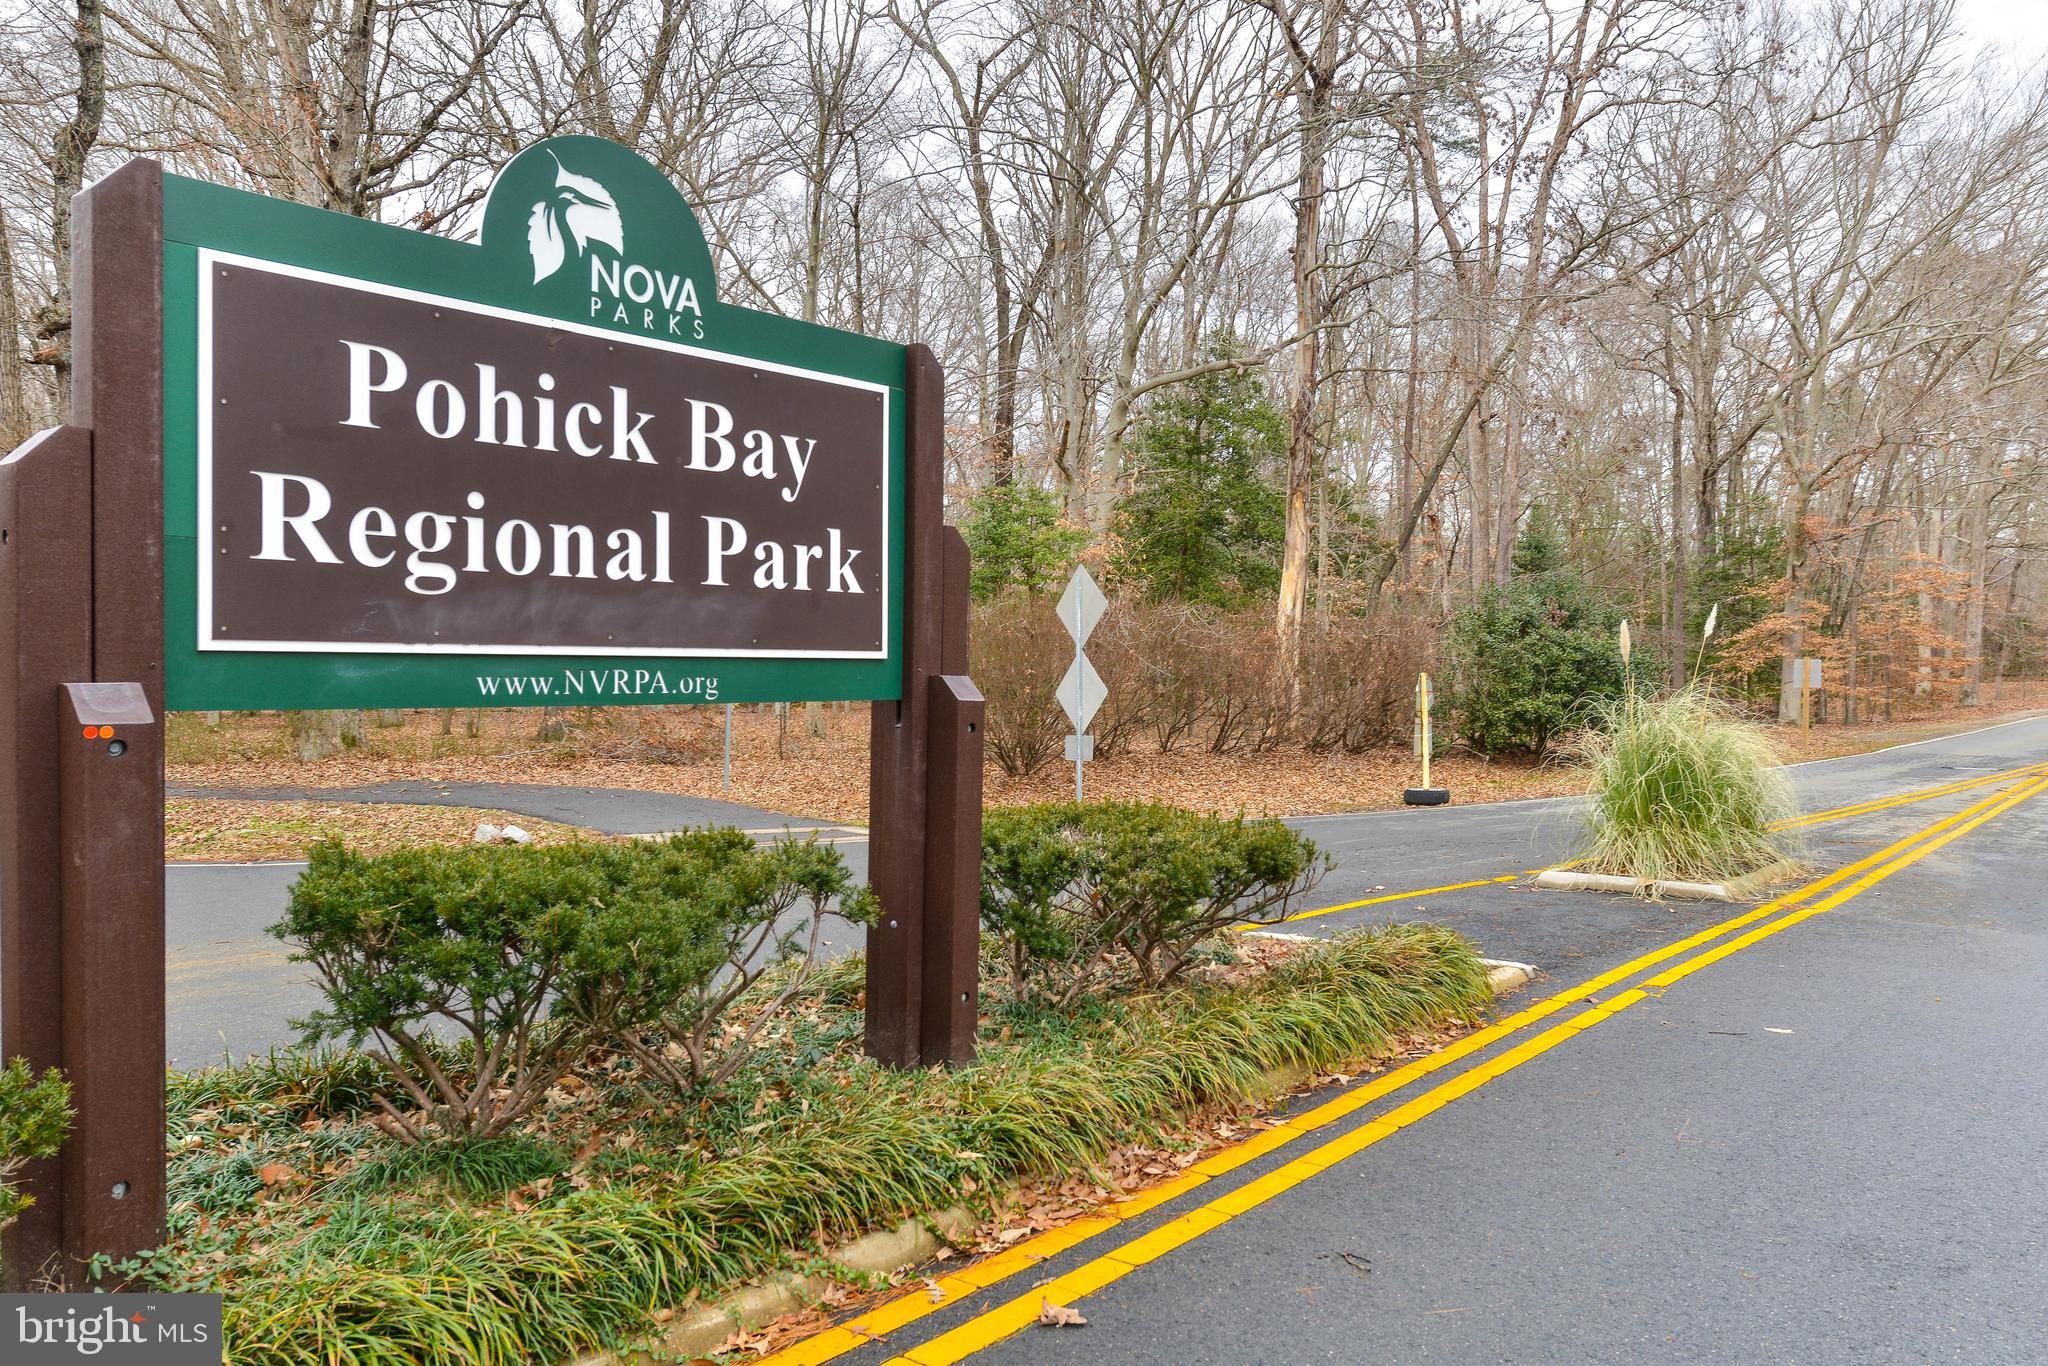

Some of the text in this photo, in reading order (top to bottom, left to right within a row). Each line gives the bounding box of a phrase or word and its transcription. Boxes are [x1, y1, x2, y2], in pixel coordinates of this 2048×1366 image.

[590, 252, 703, 317] NOVA
[590, 296, 705, 340] PARKS
[338, 339, 818, 502] Pohick Bay
[249, 470, 865, 595] Regional Park
[476, 669, 719, 701] www.NVRPA.org
